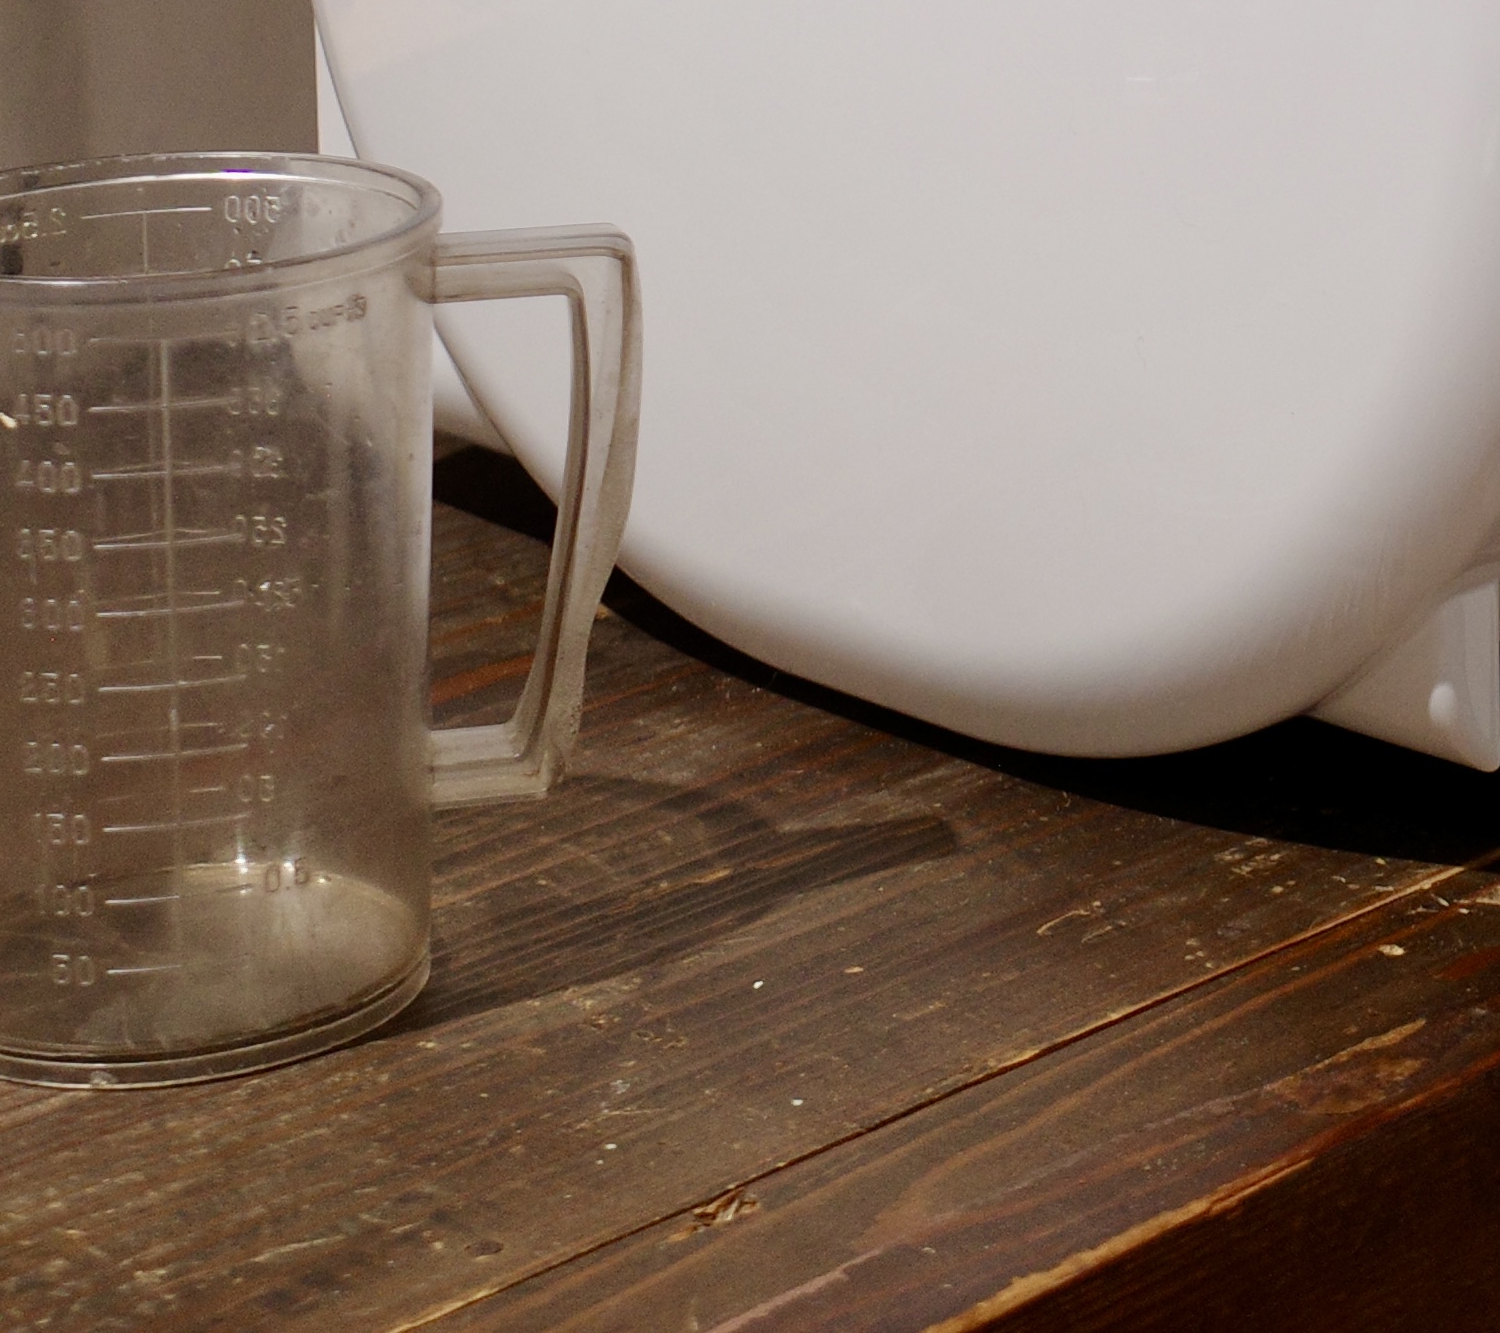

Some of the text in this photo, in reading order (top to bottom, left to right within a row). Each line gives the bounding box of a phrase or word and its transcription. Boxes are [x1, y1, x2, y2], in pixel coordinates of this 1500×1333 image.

[14, 392, 80, 427] 450
[23, 740, 91, 776] 200
[263, 858, 309, 893] 0.5
[50, 953, 96, 988] 50
